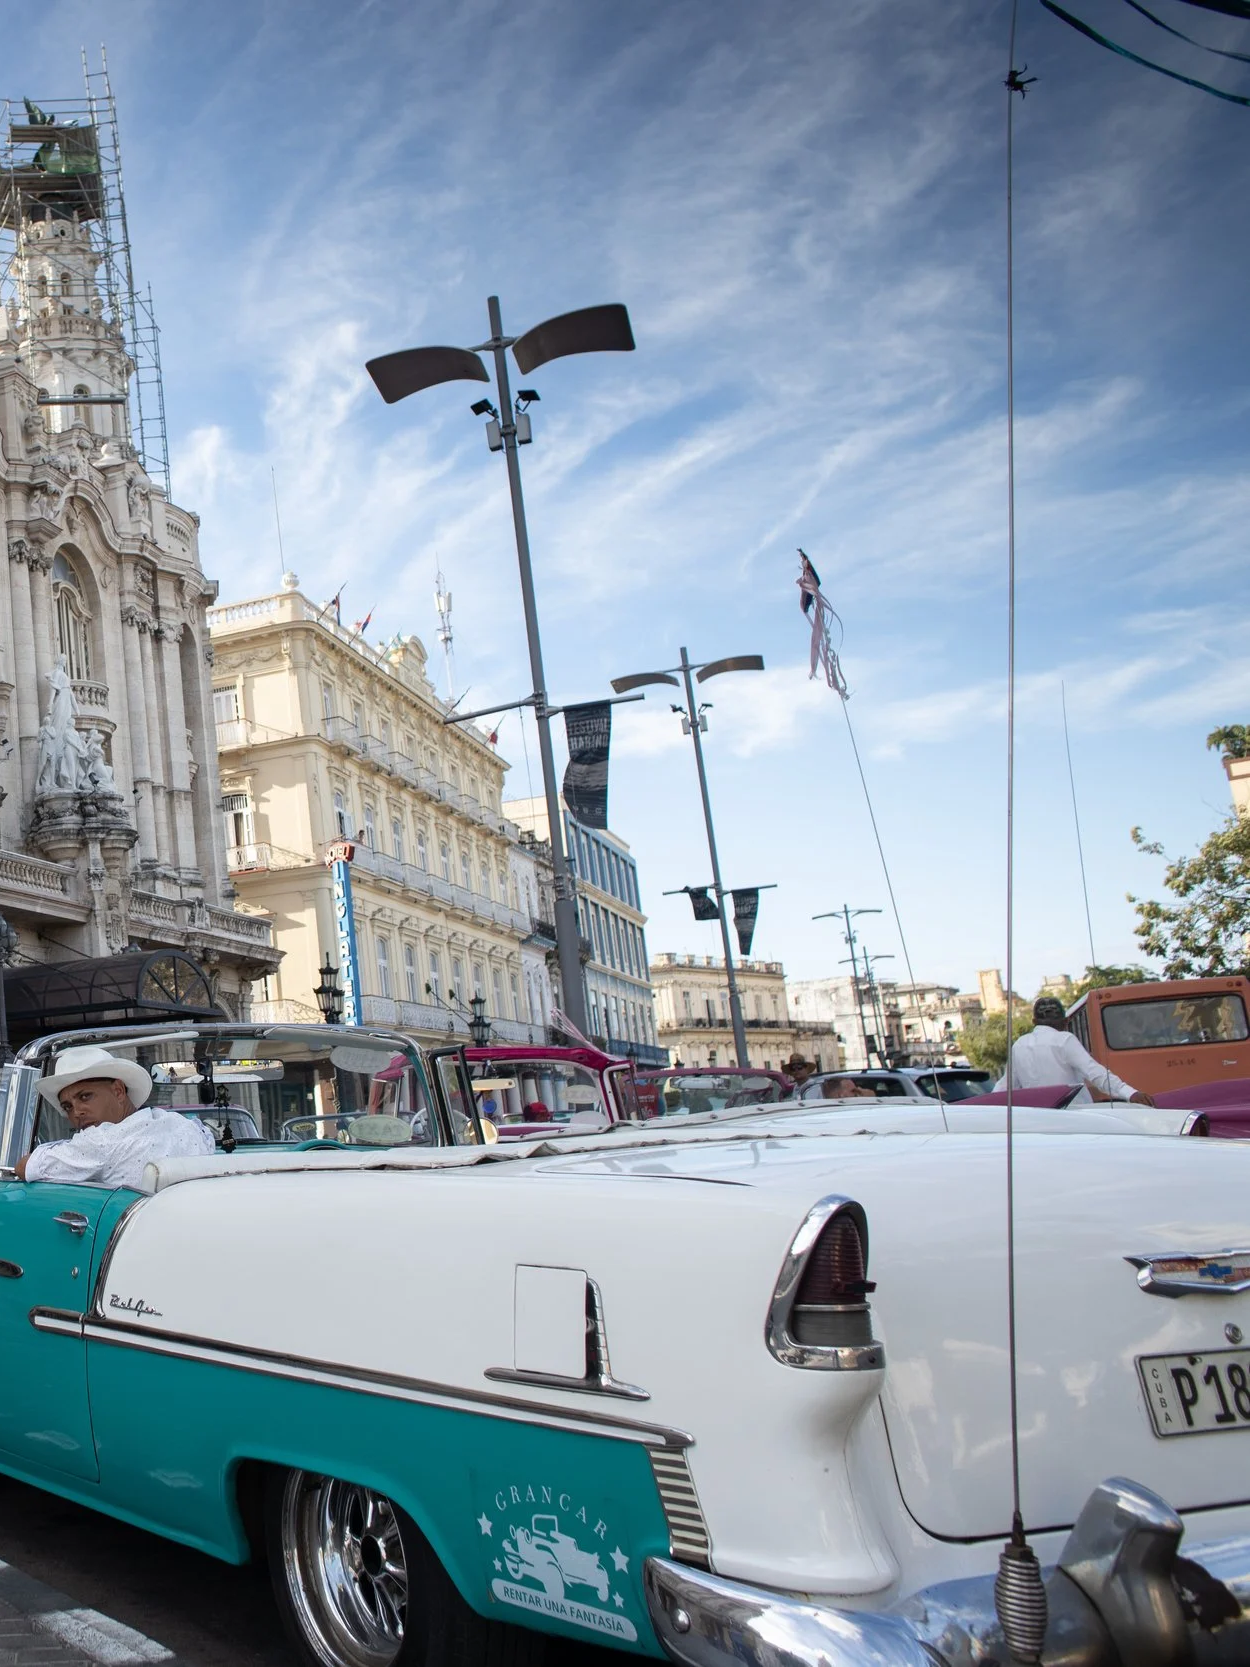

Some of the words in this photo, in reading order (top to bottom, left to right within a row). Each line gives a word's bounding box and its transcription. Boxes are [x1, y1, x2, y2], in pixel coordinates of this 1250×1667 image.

[324, 844, 349, 867] HOTEL
[1152, 1368, 1172, 1424] CUBA
[1171, 1363, 1250, 1426] P18
[503, 1586, 542, 1608] RENTAR
[543, 1598, 568, 1616] UNA
